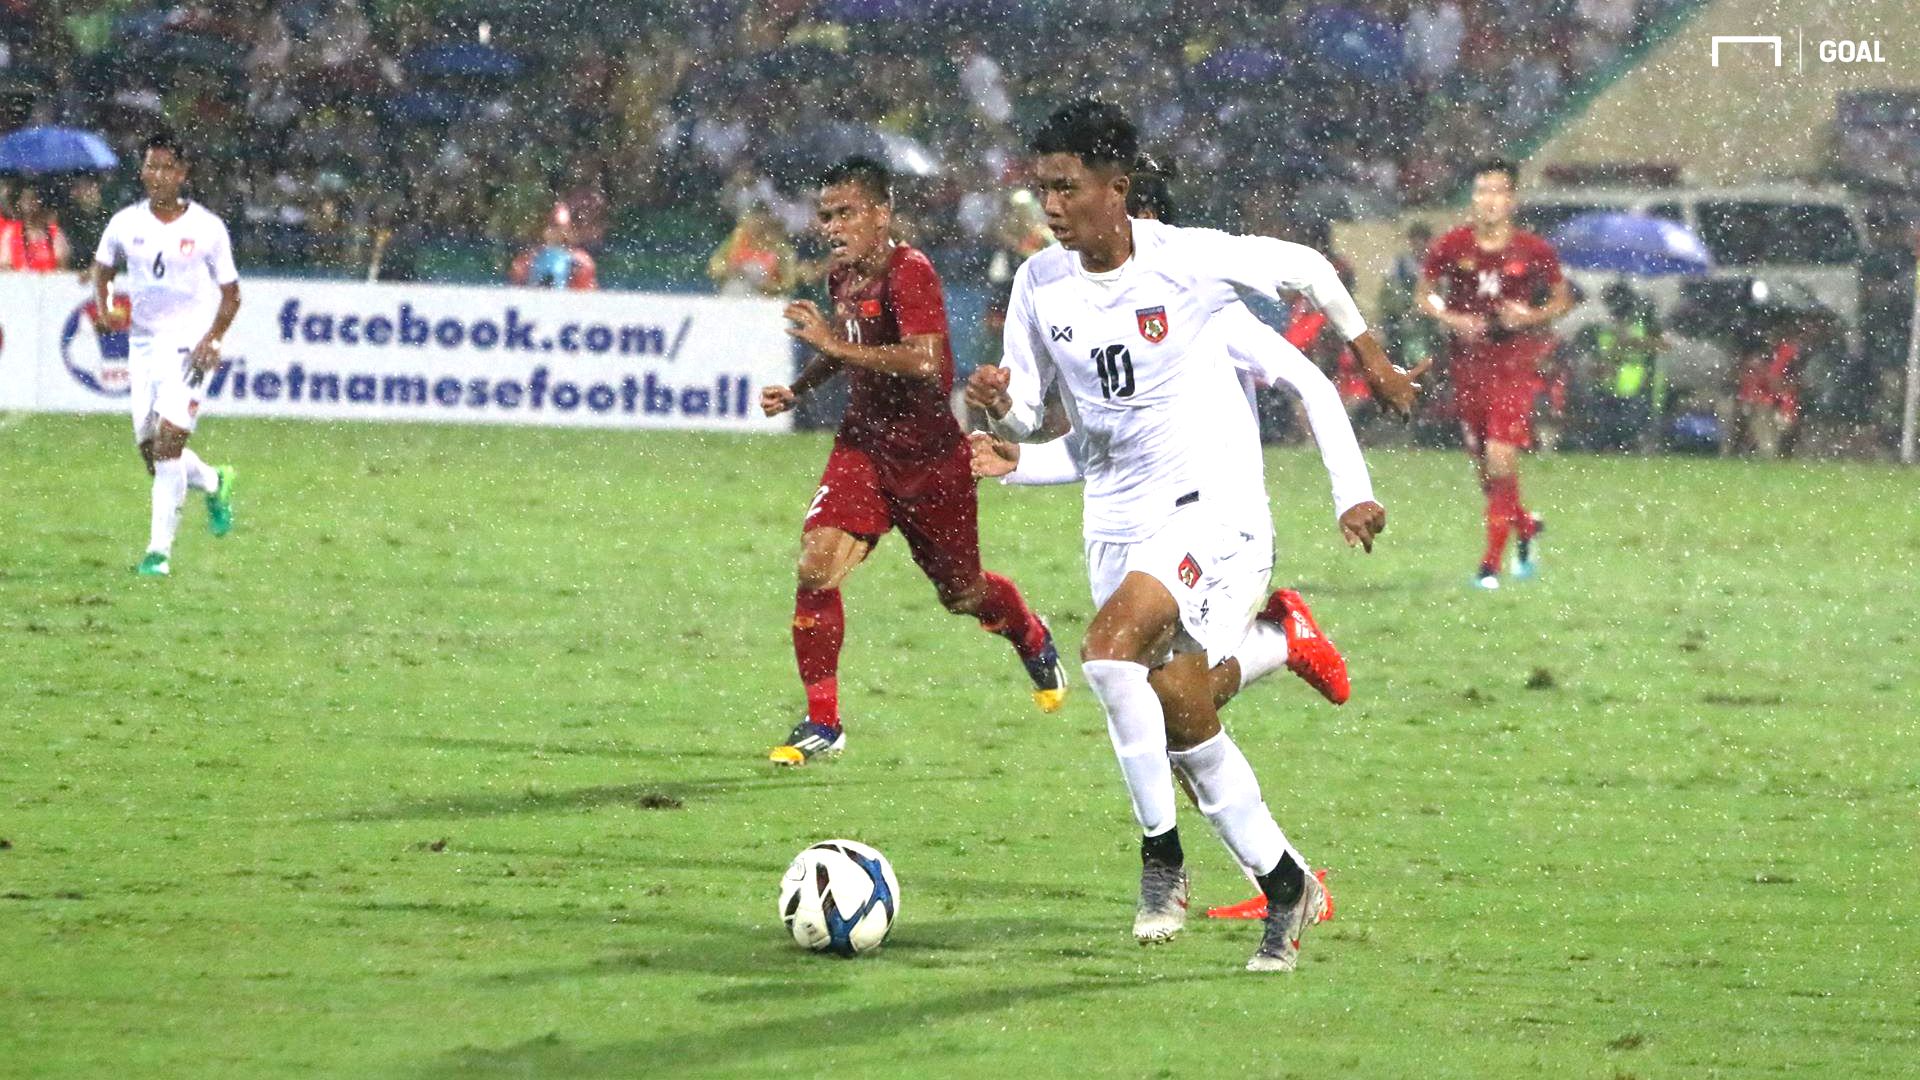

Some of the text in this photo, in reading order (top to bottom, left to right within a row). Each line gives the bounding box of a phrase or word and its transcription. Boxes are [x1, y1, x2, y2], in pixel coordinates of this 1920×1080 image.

[153, 249, 165, 279] 6
[279, 299, 692, 362] facebook.com/
[1090, 344, 1135, 400] 10
